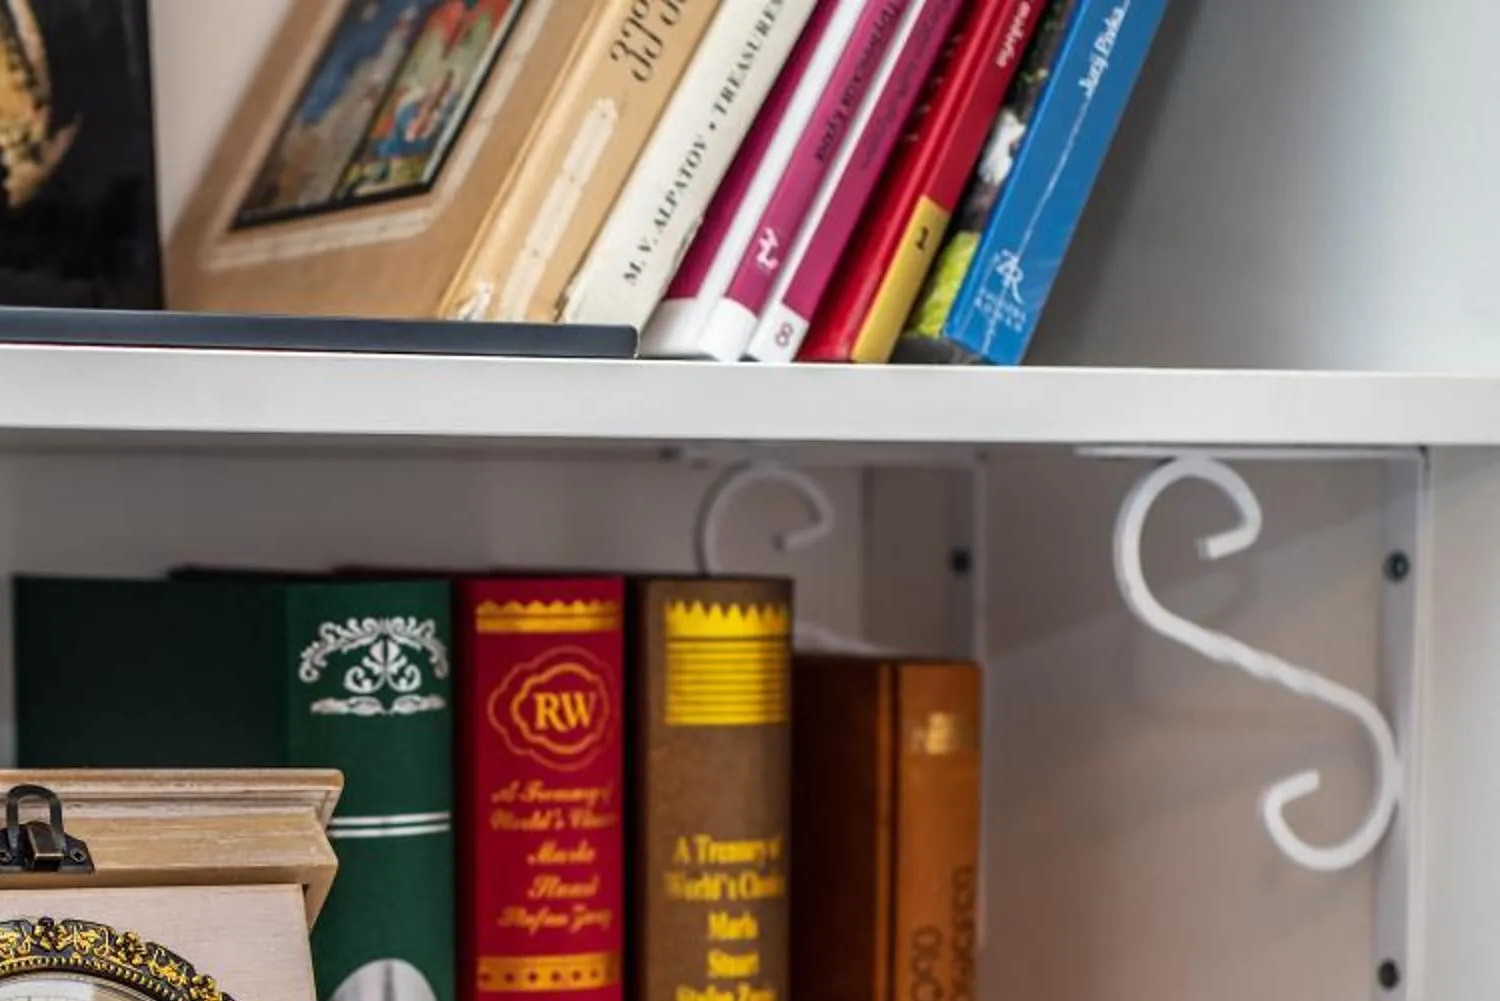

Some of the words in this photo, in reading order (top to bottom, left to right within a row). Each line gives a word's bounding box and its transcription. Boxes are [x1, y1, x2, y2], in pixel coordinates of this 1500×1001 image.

[653, 134, 708, 232] ALPATOV
[775, 322, 794, 348] 8
[533, 691, 597, 732] RW
